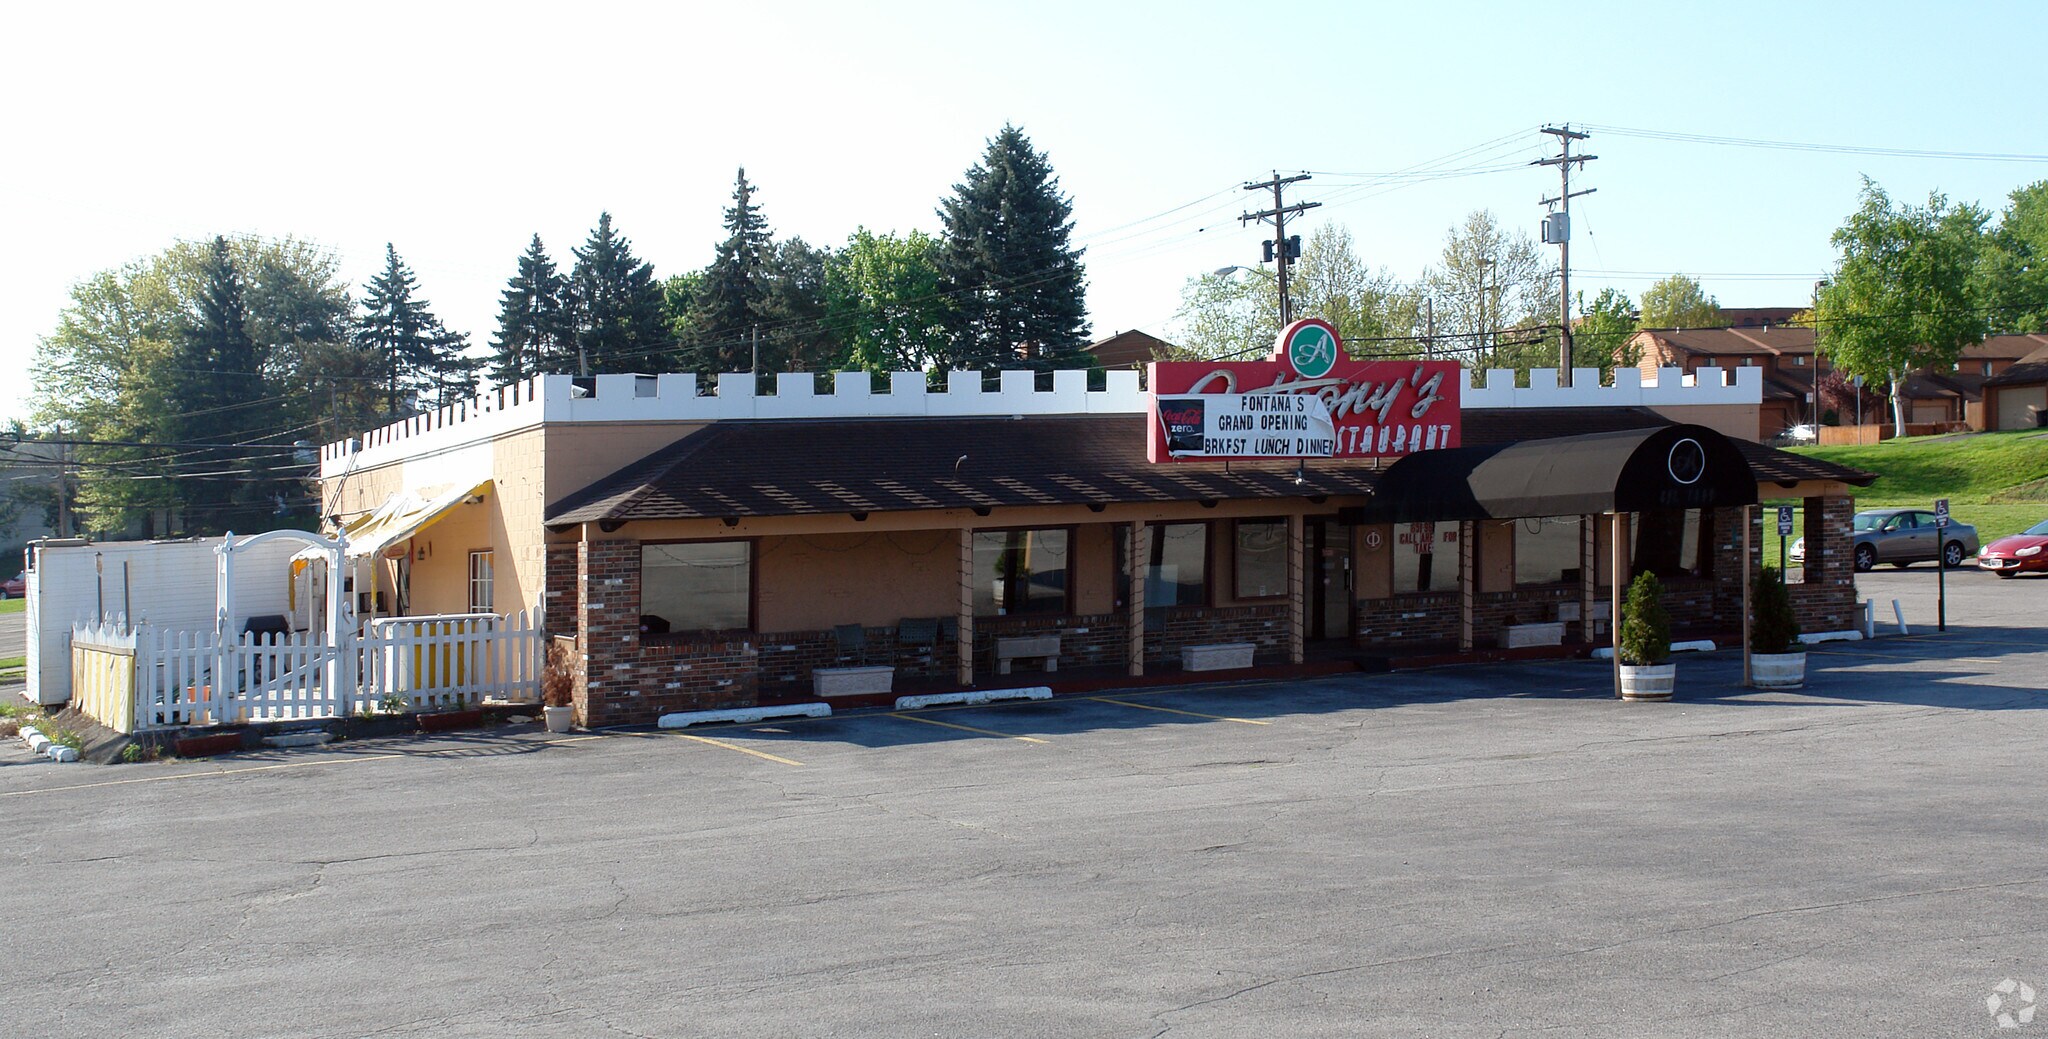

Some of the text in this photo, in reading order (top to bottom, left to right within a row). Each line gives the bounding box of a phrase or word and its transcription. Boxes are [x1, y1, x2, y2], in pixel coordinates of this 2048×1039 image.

[1294, 333, 1331, 366] A
[1241, 396, 1304, 412] FONTANA'S
[1218, 415, 1308, 431] GRAND OPENING
[1204, 438, 1334, 456] BRKFST LUNCH DINNER
[1399, 532, 1418, 544] CALL
[1443, 531, 1457, 543] FOR
